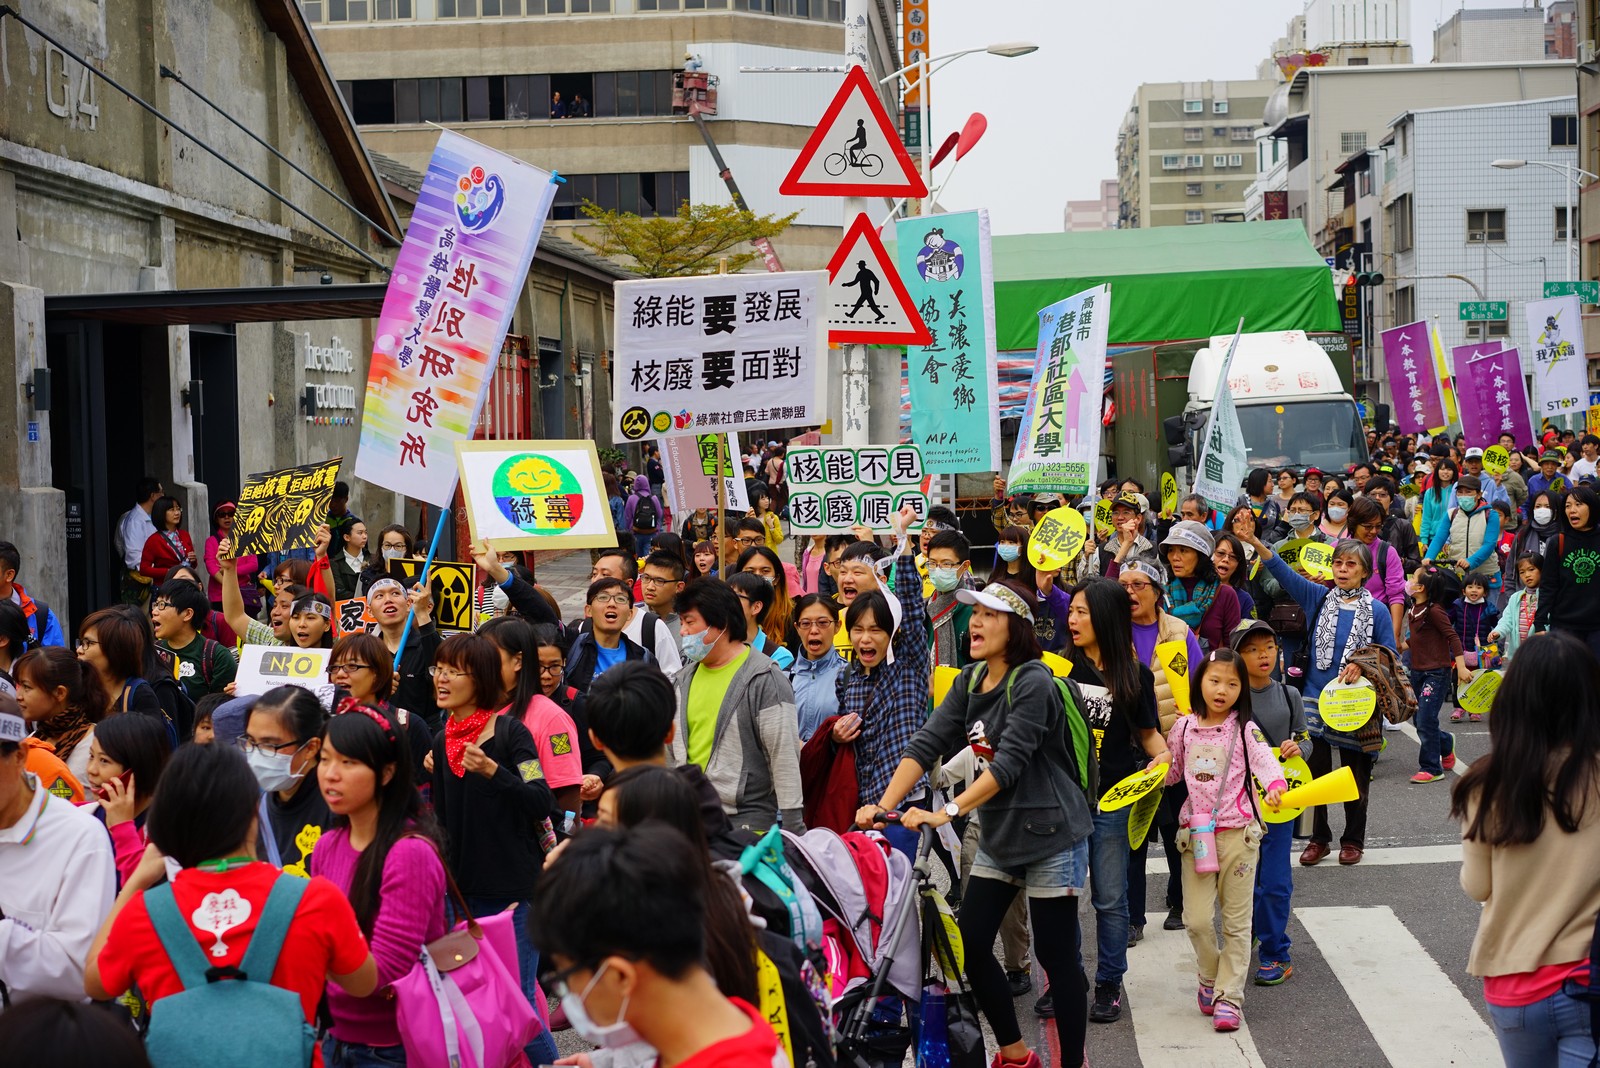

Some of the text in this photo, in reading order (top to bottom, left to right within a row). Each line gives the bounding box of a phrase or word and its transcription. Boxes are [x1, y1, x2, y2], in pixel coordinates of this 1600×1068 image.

[1550, 282, 1591, 292] 必信街
[633, 289, 802, 336] 綠能要發展
[1076, 294, 1095, 341] 高雄市
[1467, 303, 1498, 311] 必信街
[1471, 311, 1485, 319] Bisin
[919, 295, 947, 384] 協進會
[948, 289, 976, 413] 美濃愛鄉
[631, 346, 801, 392] 核廢要面對
[1033, 310, 1076, 458] 港都社區大學
[1398, 331, 1426, 426] 人本教育基金會
[1490, 362, 1514, 431] 人本教育基
[696, 405, 806, 427] 綠黨社會民主黨聯盟
[926, 431, 958, 445] MPA
[792, 452, 920, 483] 核能不見
[1028, 462, 1085, 472] (07)323-5656
[1485, 449, 1509, 468] 廢核
[240, 465, 339, 500] 拒絕核電 拒絕核電
[671, 446, 682, 479] Education
[678, 487, 687, 509] Taiwan
[508, 495, 576, 525] 綠黨
[1033, 516, 1083, 557] 廢核
[270, 655, 314, 675] NO
